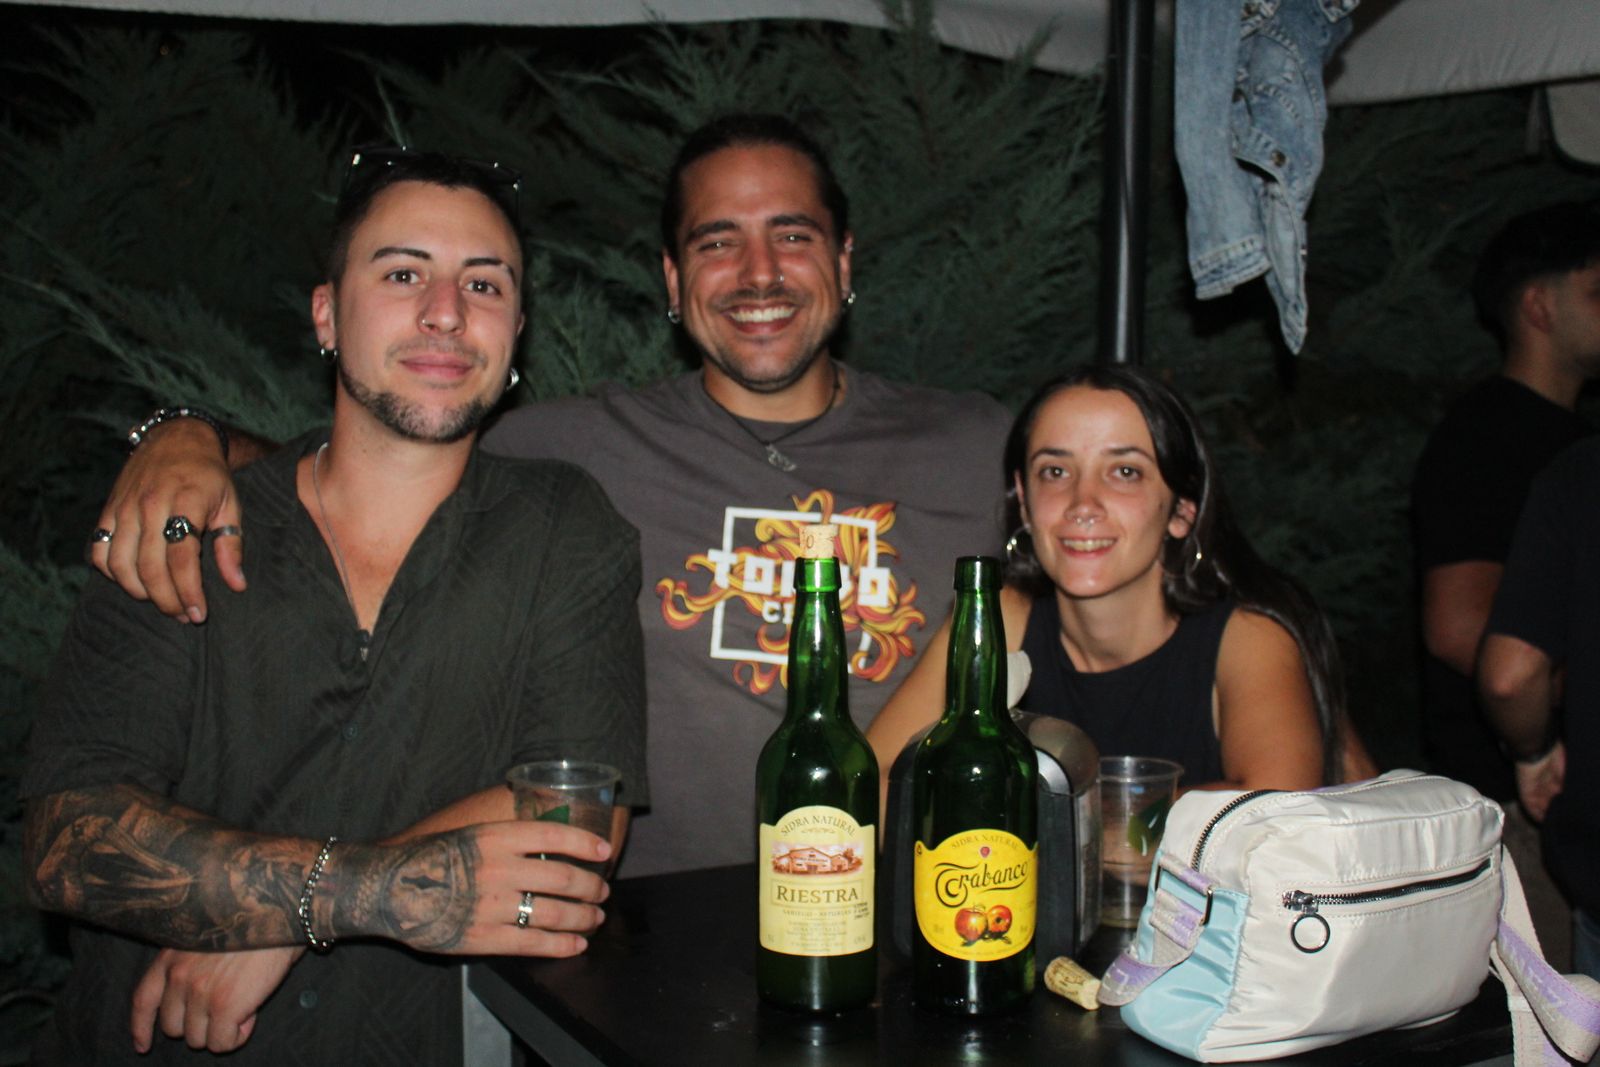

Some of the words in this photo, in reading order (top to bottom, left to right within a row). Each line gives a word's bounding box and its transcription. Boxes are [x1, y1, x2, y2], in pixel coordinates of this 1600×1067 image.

[780, 816, 809, 837] SIDRA
[811, 815, 856, 837] NATURAL
[951, 835, 980, 849] SIDRA
[933, 860, 1028, 908] Trabanco
[776, 885, 859, 904] RIESTRA
